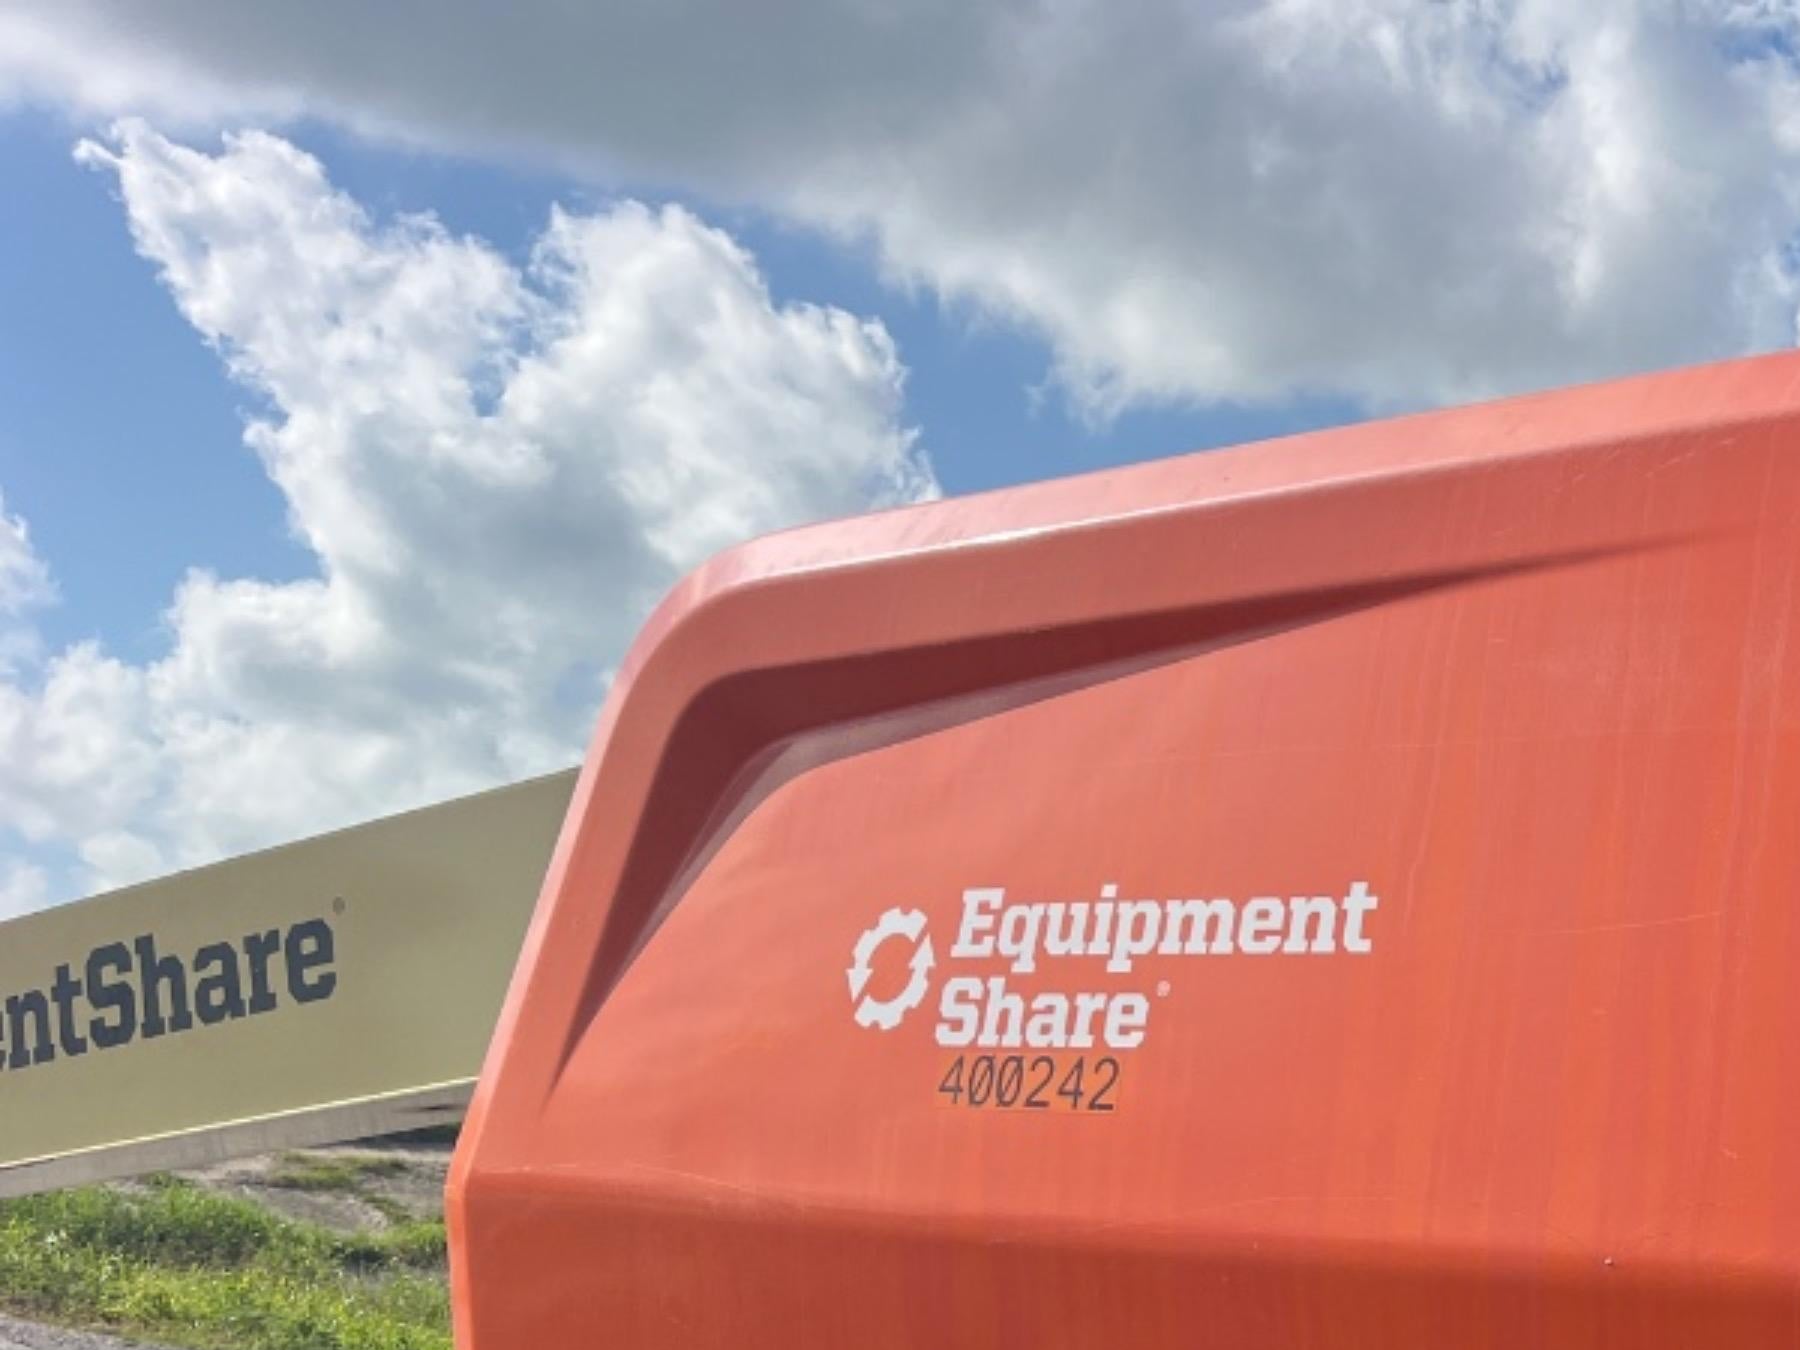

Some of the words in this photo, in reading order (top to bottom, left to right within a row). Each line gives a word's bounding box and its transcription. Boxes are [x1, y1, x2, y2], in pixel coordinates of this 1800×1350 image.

[950, 881, 1379, 973] Equipment
[0, 917, 338, 1072] ntShare
[938, 1055, 1121, 1111] 400242
